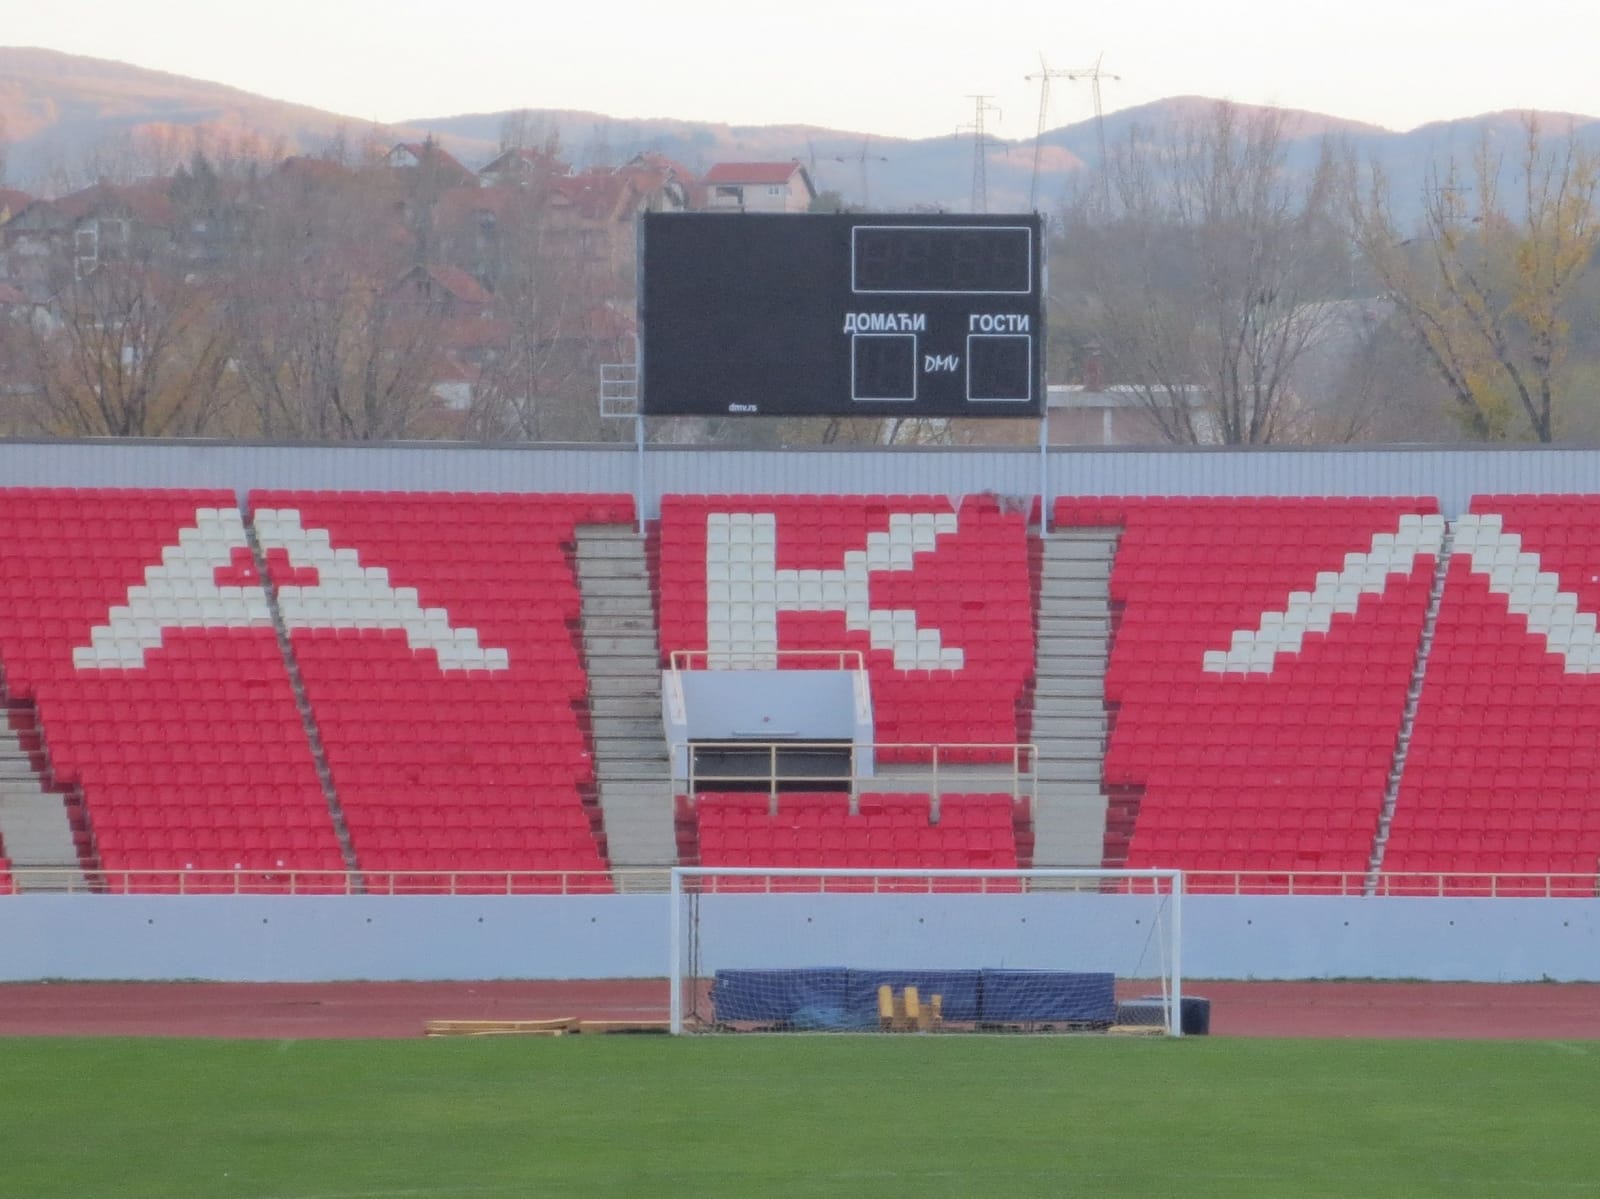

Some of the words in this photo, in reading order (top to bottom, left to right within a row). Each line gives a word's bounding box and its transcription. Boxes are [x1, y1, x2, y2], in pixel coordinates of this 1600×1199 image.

[843, 312, 926, 334] ДОМАЋИ
[969, 313, 1030, 332] ГОСТИ
[924, 354, 960, 373] DMV
